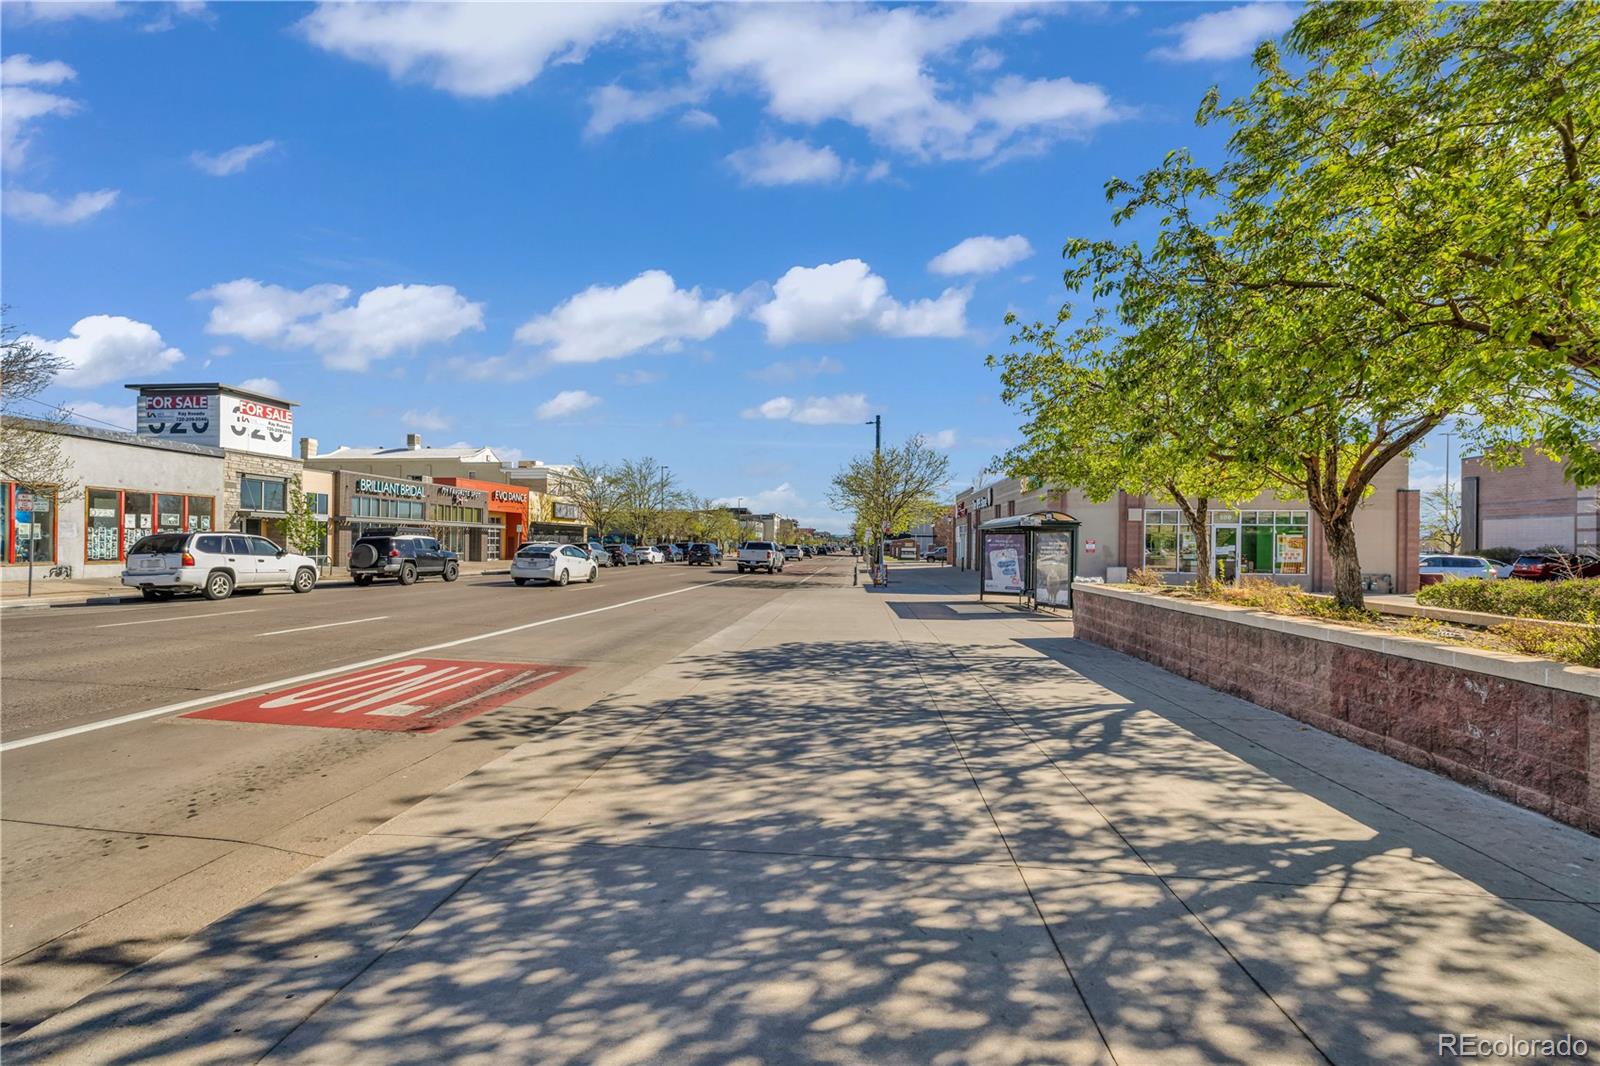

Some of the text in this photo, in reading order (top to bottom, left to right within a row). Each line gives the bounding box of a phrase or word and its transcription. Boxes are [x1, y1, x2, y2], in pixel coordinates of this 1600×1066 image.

[146, 396, 208, 409] FOR SALE
[240, 401, 263, 416] FOR
[265, 407, 292, 422] SALE
[360, 479, 425, 498] BRILLIANT BRIDAL
[495, 490, 527, 503] EVO DANCE
[259, 664, 560, 719] ONLY
